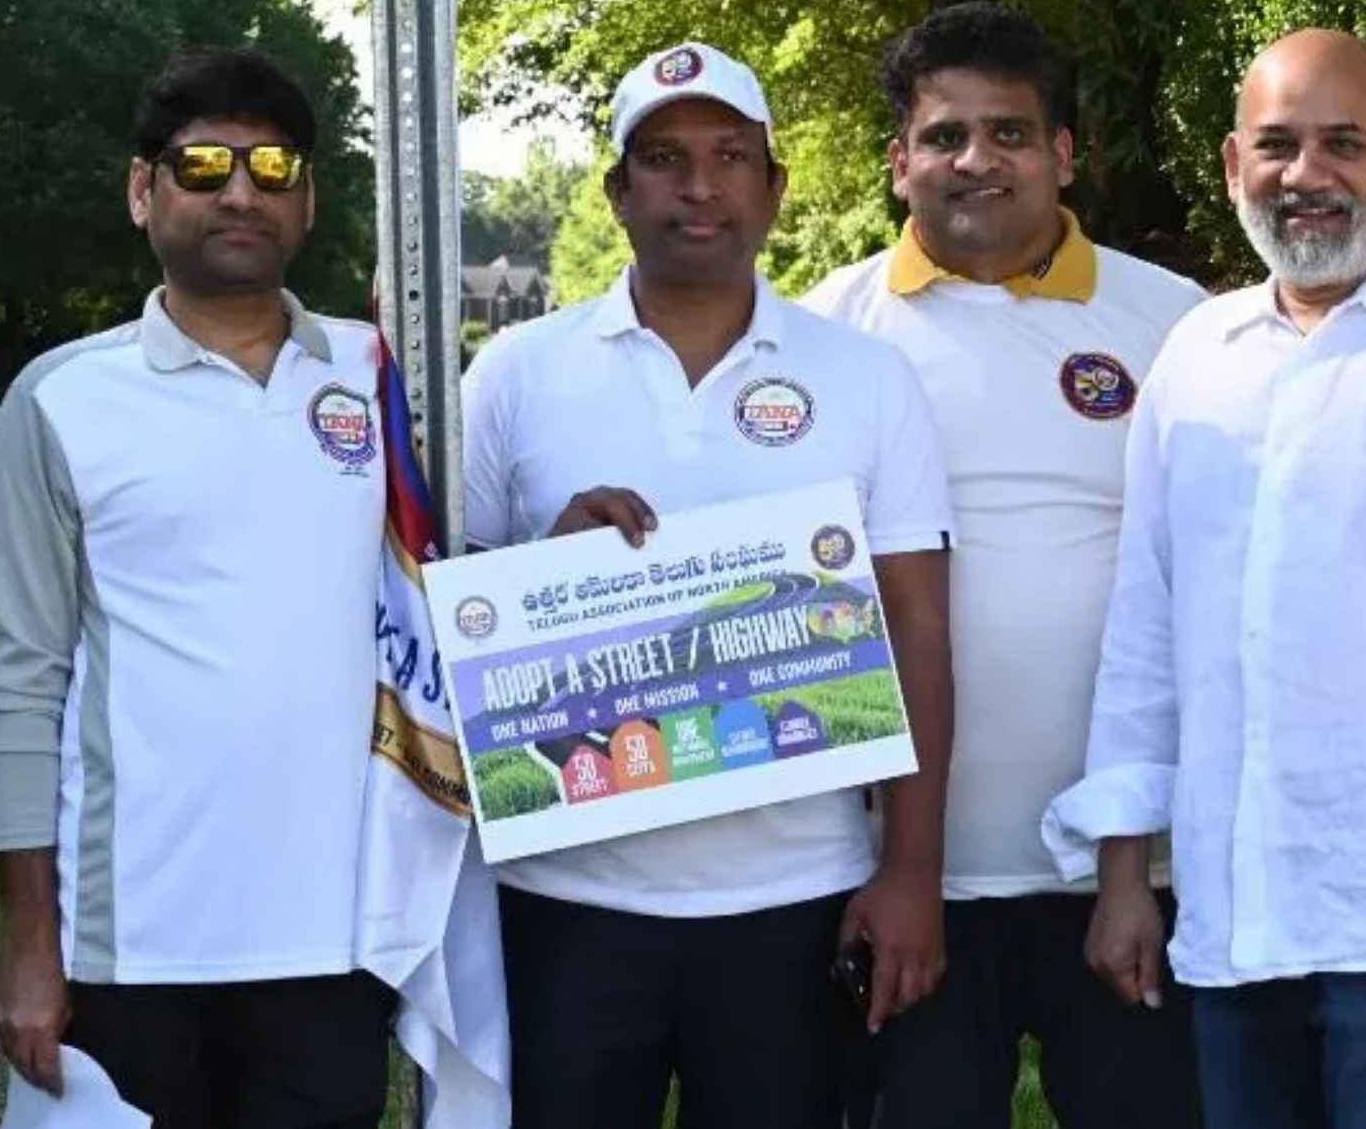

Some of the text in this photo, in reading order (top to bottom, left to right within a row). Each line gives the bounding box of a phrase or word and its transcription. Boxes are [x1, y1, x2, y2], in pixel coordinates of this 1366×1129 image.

[581, 595, 666, 620] ASSOCIATION
[687, 582, 731, 599] NORTH
[483, 657, 557, 711] ADOPT
[567, 654, 584, 695] A
[587, 632, 675, 690] STREET
[710, 605, 812, 664] HIGHWAY
[749, 651, 852, 687] ONE COMMUNITY
[615, 683, 700, 715] ONE MISSION
[491, 711, 569, 742] ONE NATION
